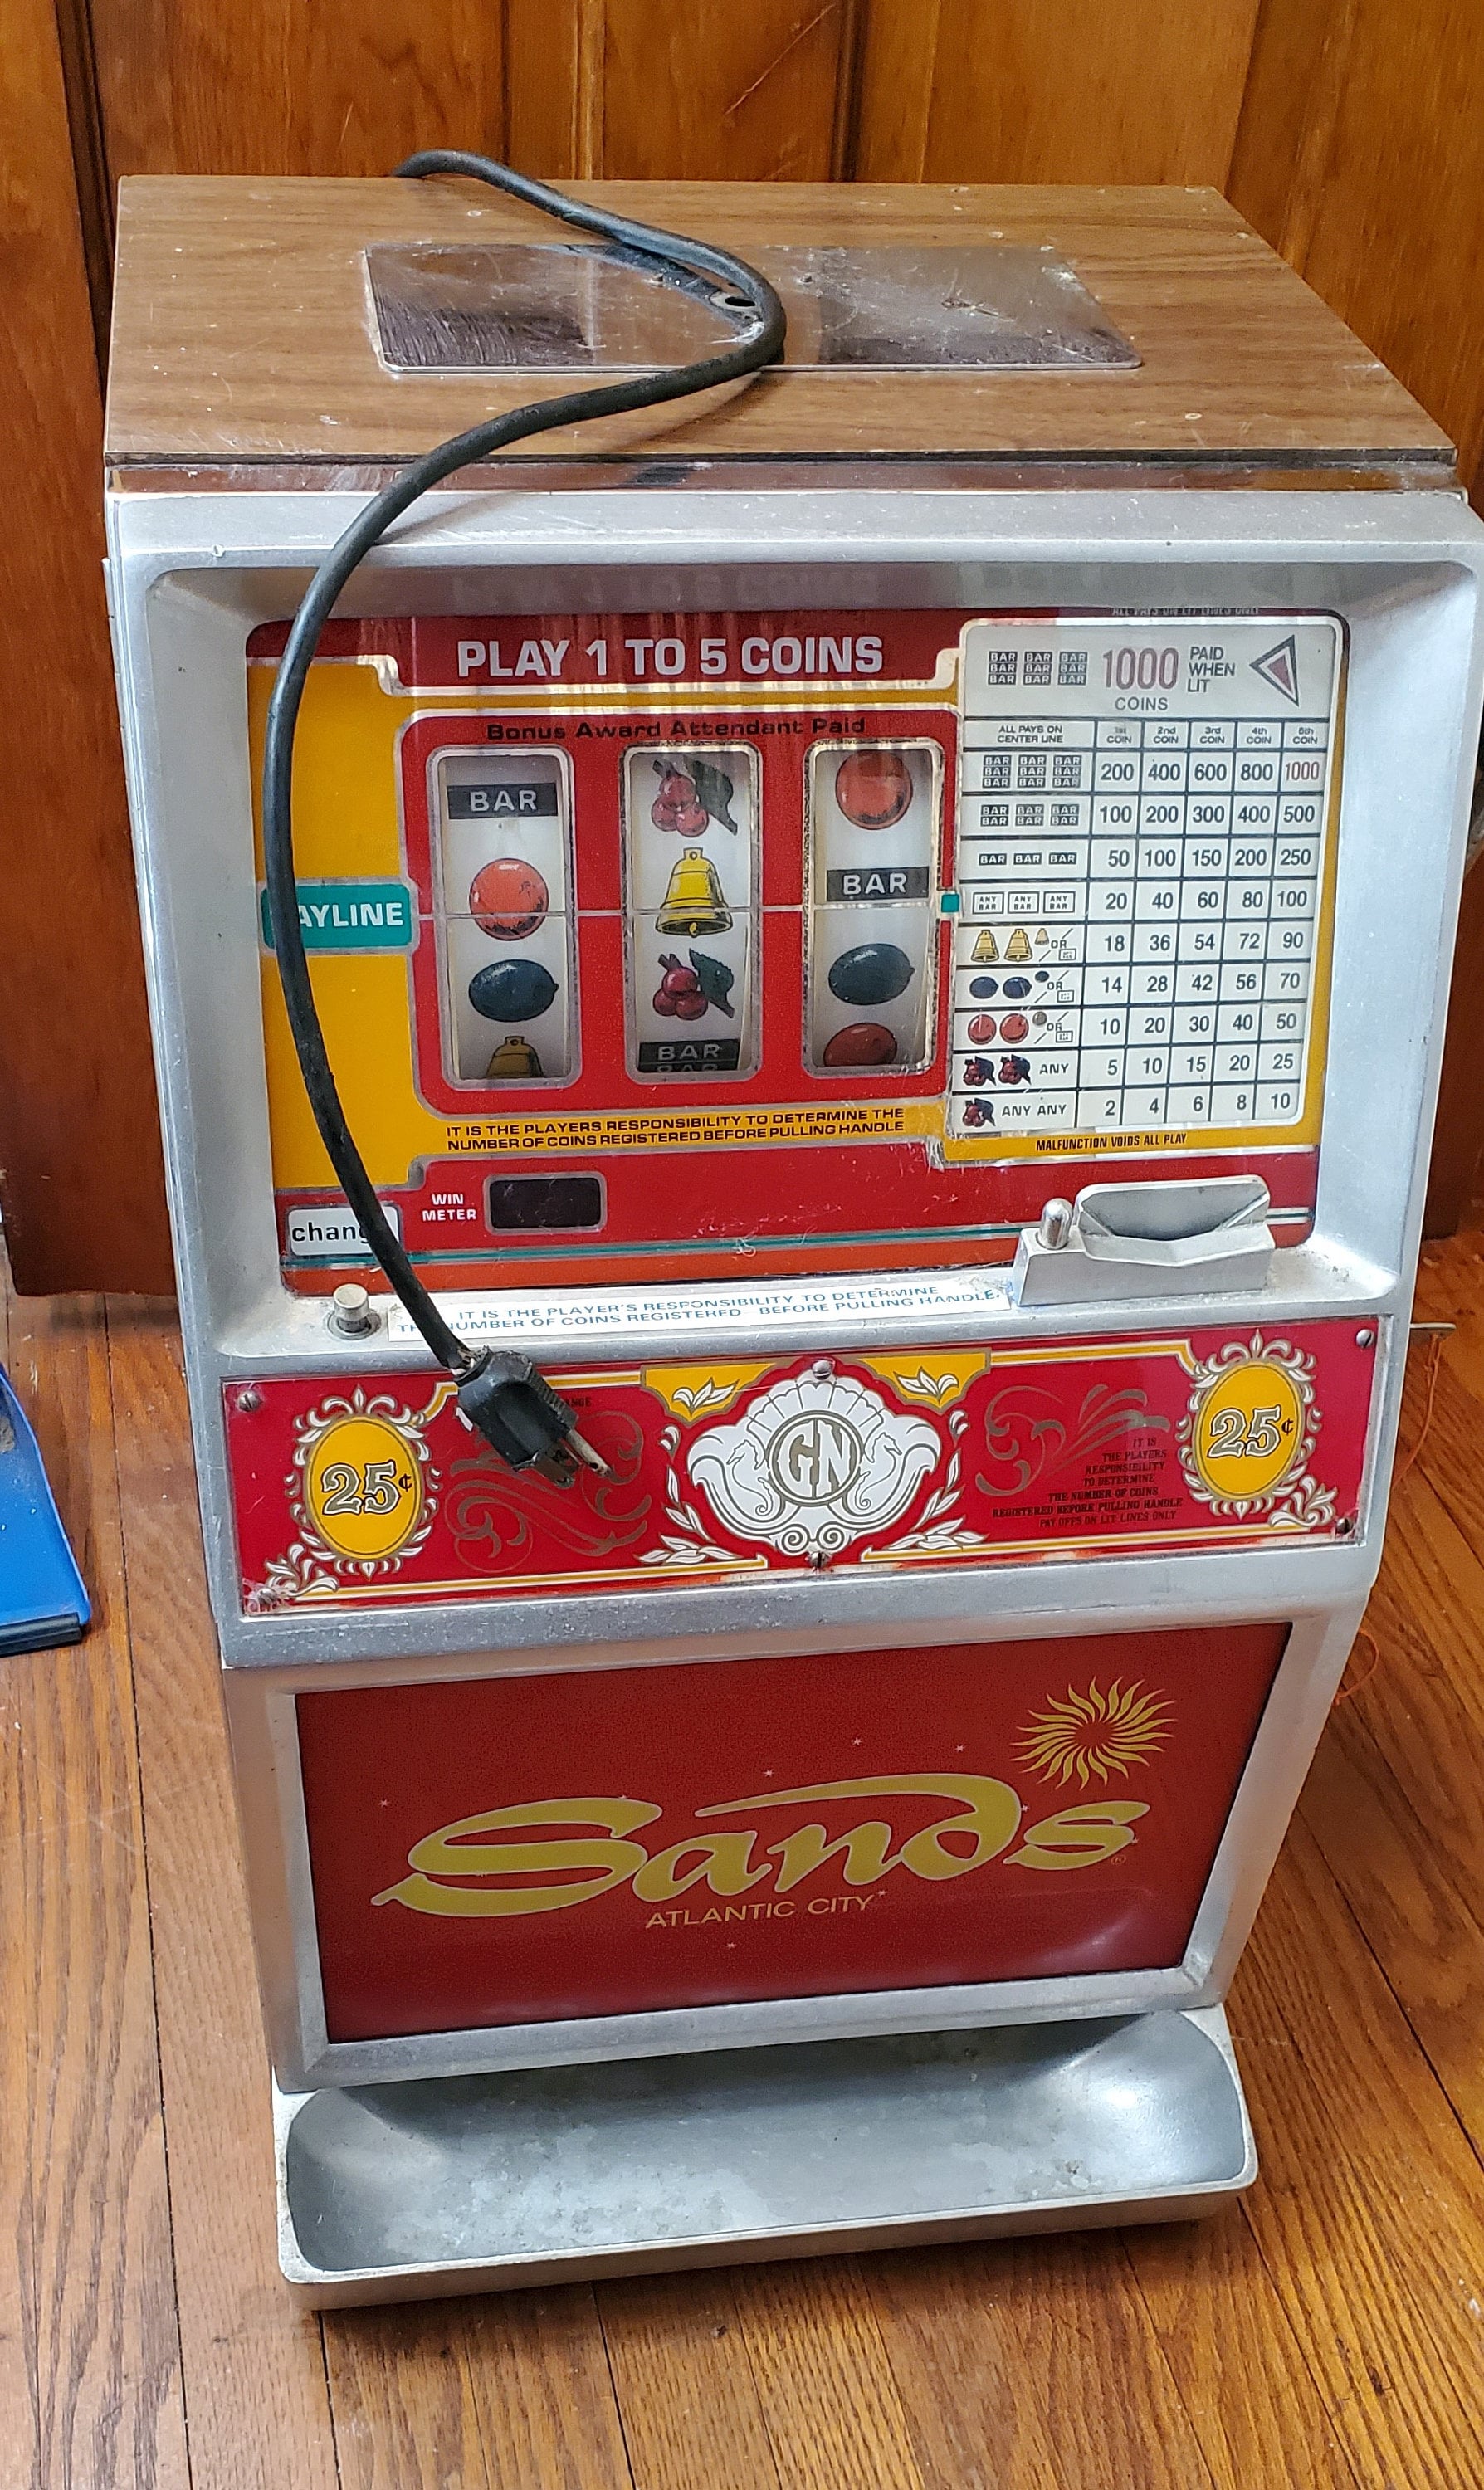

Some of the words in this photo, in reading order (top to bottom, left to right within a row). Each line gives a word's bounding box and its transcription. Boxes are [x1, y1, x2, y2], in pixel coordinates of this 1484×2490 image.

[458, 638, 570, 677] PLAY
[586, 638, 608, 676] 1
[625, 638, 686, 675] TO
[701, 637, 727, 674] 5
[742, 636, 882, 674] COINS
[1190, 647, 1224, 661] PAID
[1102, 648, 1179, 690] 1000
[1189, 662, 1235, 676] WHEN
[1187, 680, 1208, 693] LIT
[1115, 696, 1168, 711] COINS
[486, 724, 565, 740] Bonus
[576, 722, 660, 739] Award
[670, 720, 803, 737] Attendant
[812, 718, 865, 735] Paid
[1158, 726, 1176, 735] 2nd
[1205, 726, 1221, 735] 3rd
[1252, 726, 1267, 735] 4th
[1106, 735, 1131, 744] COIN
[1154, 735, 1179, 744] COIN
[1200, 735, 1224, 744] COIN
[1101, 763, 1134, 781] 200
[1148, 763, 1180, 781] 400
[1194, 764, 1227, 781] 600
[1241, 764, 1273, 781] 800
[1286, 762, 1320, 781] 1000
[470, 790, 537, 813] BAR
[1100, 805, 1131, 823] 100
[1145, 805, 1179, 823] 200
[1193, 805, 1225, 823] 300
[1238, 804, 1270, 823] 400
[1283, 804, 1315, 823] 500
[981, 855, 1005, 863] BAR
[1051, 854, 1075, 862] BAR
[1108, 850, 1130, 867] 50
[1145, 850, 1176, 867] 100
[1193, 849, 1222, 867] 150
[1234, 849, 1267, 866] 200
[1280, 848, 1311, 866] 250
[842, 872, 906, 895] BAR
[1106, 893, 1127, 910] 20
[1152, 892, 1174, 909] 40
[1198, 891, 1219, 908] 60
[1242, 891, 1263, 908] 80
[1277, 891, 1307, 907] 100
[298, 902, 403, 928] AYLINE
[1051, 940, 1067, 949] OR
[1104, 935, 1125, 952] 18
[1149, 935, 1170, 951] 36
[1195, 934, 1215, 950] 54
[1239, 934, 1260, 950] 72
[1283, 932, 1303, 949] 90
[1101, 977, 1122, 994] 14
[1147, 976, 1168, 992] 28
[1192, 974, 1213, 991] 42
[1236, 974, 1256, 990] 56
[1280, 973, 1301, 989] 70
[1047, 1023, 1062, 1031] OR
[1101, 1019, 1120, 1035] 10
[1145, 1018, 1166, 1034] 20
[1189, 1016, 1209, 1033] 30
[1233, 1015, 1252, 1031] 40
[1276, 1013, 1296, 1029] 50
[658, 1044, 720, 1060] BAR
[1040, 1062, 1069, 1075] ANY
[1107, 1060, 1118, 1076] 5
[1143, 1058, 1163, 1075] 10
[1186, 1057, 1206, 1073] 15
[1229, 1056, 1250, 1072] 20
[1273, 1054, 1293, 1070] 25
[1002, 1104, 1031, 1117] ANY
[1037, 1104, 1067, 1116] ANY
[1105, 1101, 1115, 1117] 2
[1150, 1098, 1159, 1114] 4
[1194, 1096, 1203, 1112] 6
[1236, 1095, 1247, 1111] 8
[1271, 1093, 1291, 1110] 10
[447, 1127, 461, 1136] IT
[466, 1126, 481, 1135] IS
[487, 1125, 519, 1135] THE
[525, 1122, 601, 1134] PLAYERS
[607, 1116, 740, 1130] RESPONSIBILITY
[745, 1115, 767, 1125] TO
[773, 1110, 867, 1124] DETERMINE
[872, 1108, 904, 1118] THE
[448, 1138, 519, 1150] NUMBER
[523, 1138, 544, 1147] OF
[548, 1135, 596, 1146] COINS
[601, 1130, 701, 1144] REGISTERED
[704, 1129, 766, 1140] BEFORE
[770, 1125, 835, 1137] PULLING
[839, 1121, 903, 1134] HANDLE
[1037, 1137, 1107, 1151] MALFUNCTION
[1111, 1135, 1140, 1147] VOIDS
[1144, 1135, 1160, 1145] ALL
[1164, 1134, 1186, 1145] PLAY
[432, 1194, 463, 1205] WIN
[422, 1208, 476, 1221] METER
[460, 1311, 475, 1320] IT
[505, 1309, 540, 1317] THE
[548, 1304, 637, 1316] PLAYER'S
[644, 1295, 793, 1311] RESPONSIBILITY
[802, 1294, 826, 1302] TO
[832, 1286, 938, 1301] DETERMINE
[561, 1315, 621, 1325] COINS
[627, 1308, 741, 1321] REGISTERED
[759, 1304, 828, 1315] BEFORE
[835, 1298, 914, 1310] PULLING
[920, 1291, 1000, 1305] HANDLE.
[1133, 1438, 1143, 1447] IT
[1148, 1438, 1156, 1446] IS
[778, 1419, 854, 1498] GN
[1102, 1452, 1120, 1462] THE
[1125, 1449, 1166, 1461] PLAYERS
[1084, 1477, 1095, 1486] TO
[1098, 1474, 1154, 1485] DETERMINE
[1049, 1493, 1068, 1502] THE
[1072, 1489, 1111, 1499] NUMBER
[1115, 1488, 1127, 1496] OF
[1130, 1487, 1158, 1496] COINS
[1120, 1512, 1149, 1522] LINES
[1153, 1511, 1176, 1520] ONLY
[371, 1772, 1150, 1917] Sands
[646, 1901, 796, 1928] ATLANTIC
[808, 1895, 875, 1915] CITY
